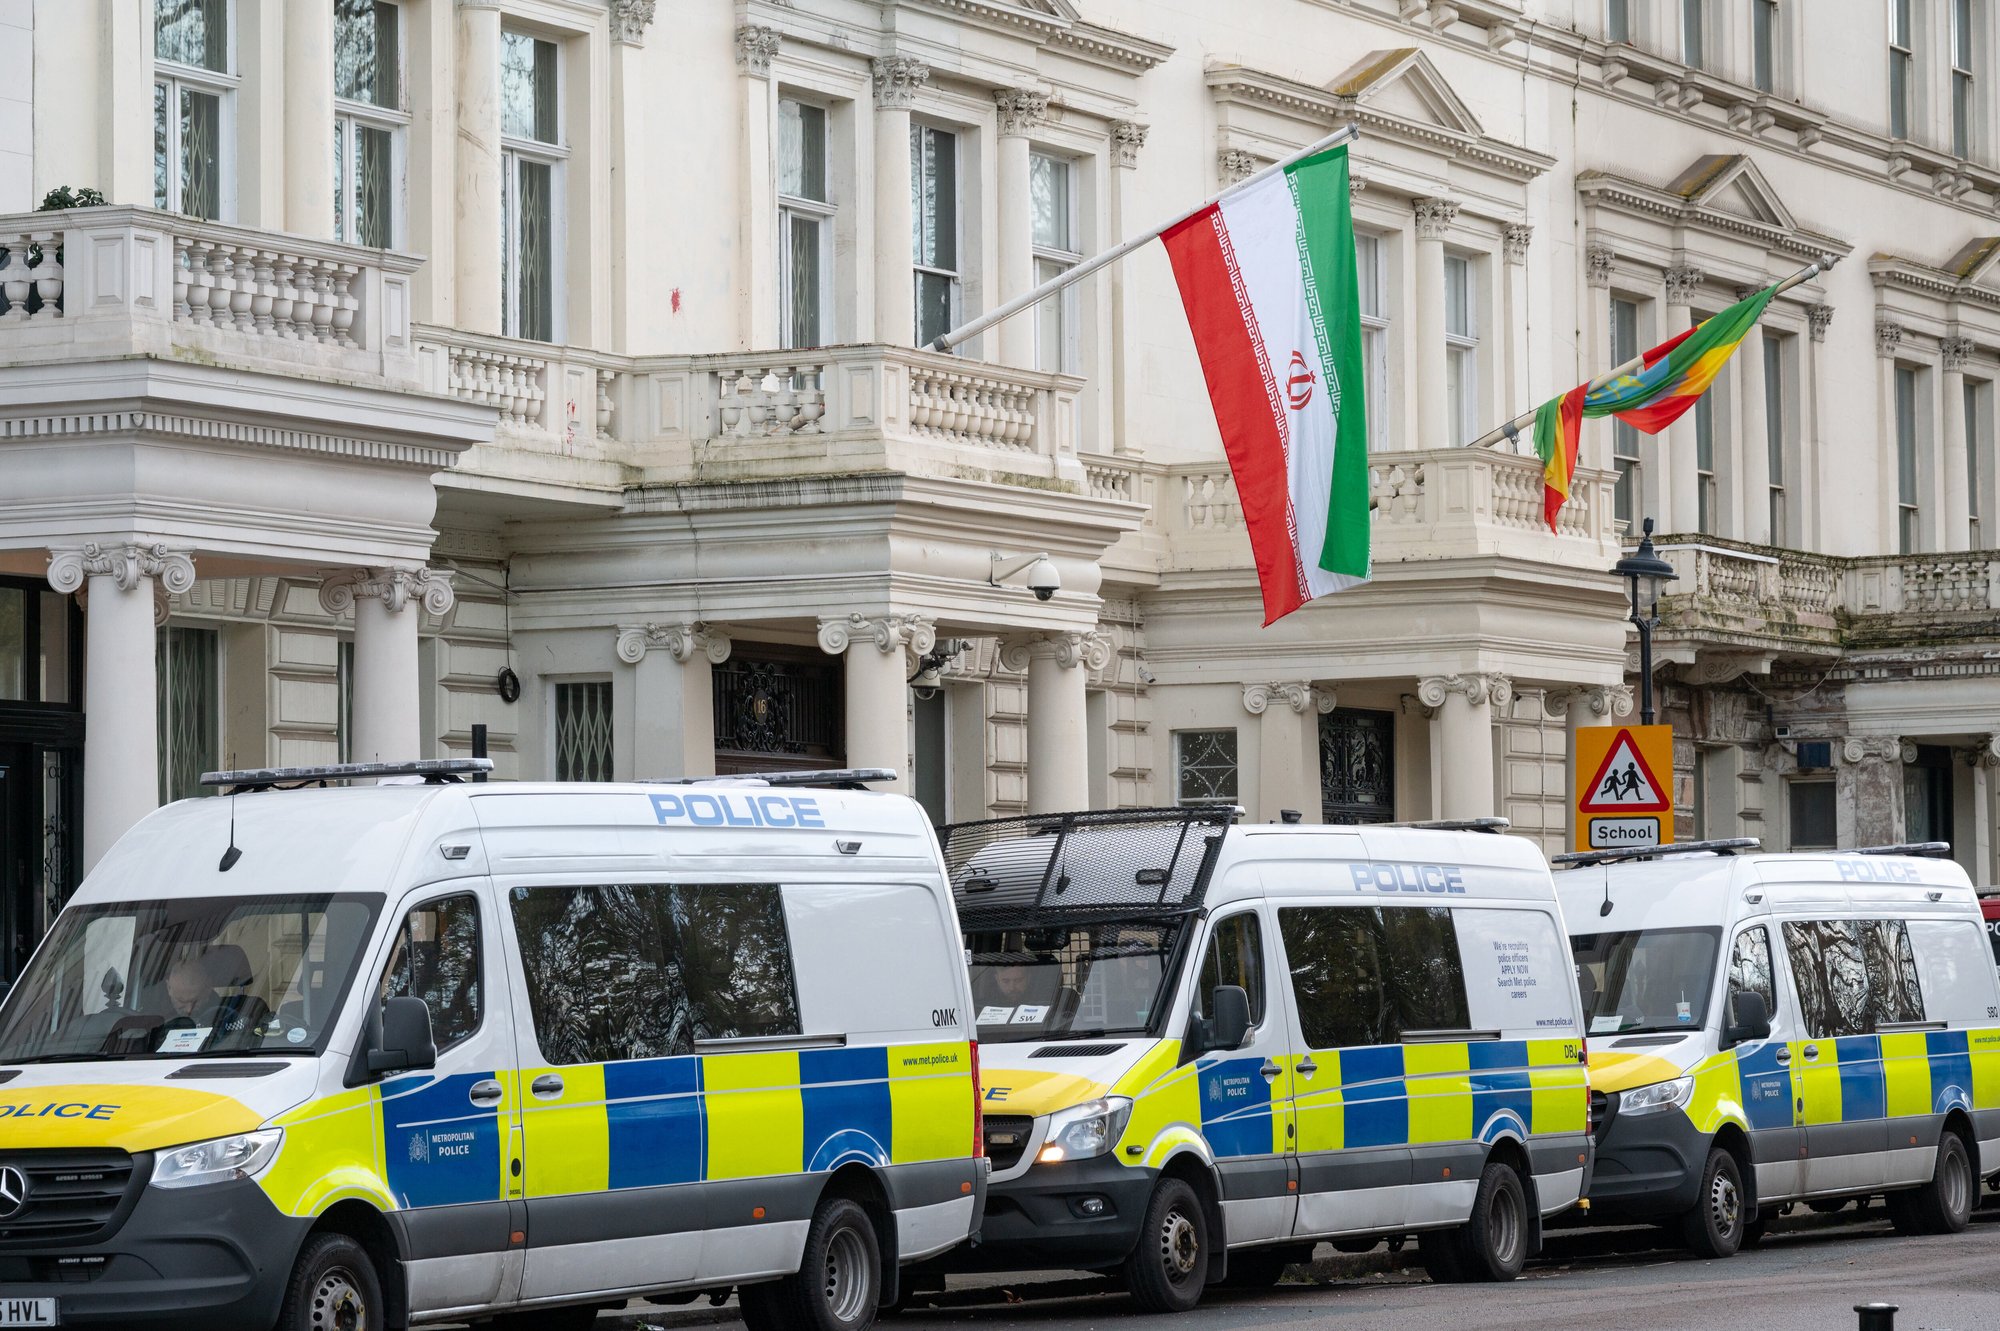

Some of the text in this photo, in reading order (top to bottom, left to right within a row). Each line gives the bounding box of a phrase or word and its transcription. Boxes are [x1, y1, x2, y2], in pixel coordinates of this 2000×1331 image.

[757, 699, 767, 714] 16
[648, 794, 826, 828] POLICE
[1597, 825, 1653, 839] School
[1834, 860, 1922, 882] POLICE
[1348, 864, 1466, 893] POLICE
[1493, 941, 1528, 952] We're recruiting
[1498, 953, 1528, 964] police officers
[1501, 965, 1528, 974] APPLY NOW
[1497, 976, 1537, 988] Search Met police
[932, 1008, 958, 1027] QMK
[1535, 1017, 1574, 1027] www.met.police.uk
[1564, 1045, 1577, 1058] DBJ
[902, 1053, 958, 1067] www.met.police.uk
[1223, 1077, 1250, 1086] METROPOLITAN
[1227, 1087, 1247, 1096] POLICE
[432, 1132, 475, 1143] METROPOLITAN
[439, 1145, 469, 1156] POLICE
[9, 1301, 47, 1322] HVL
